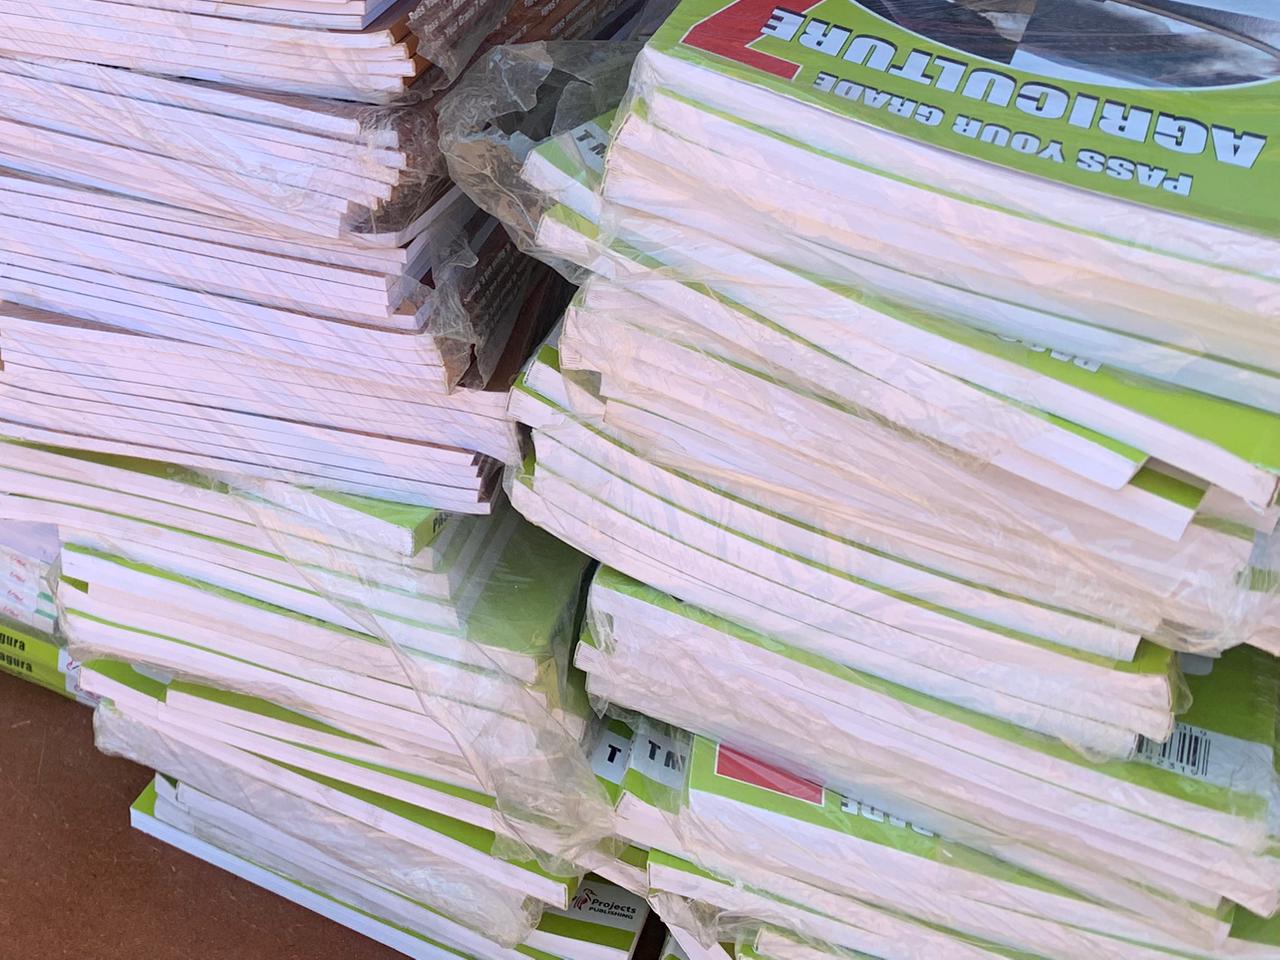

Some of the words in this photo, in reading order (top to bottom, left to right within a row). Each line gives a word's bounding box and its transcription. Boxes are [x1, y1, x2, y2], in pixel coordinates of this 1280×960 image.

[408, 3, 424, 22] Pass
[760, 8, 1268, 169] AGRICULTURE
[814, 71, 945, 127] GRADE
[952, 113, 1068, 164] YOUR
[1076, 147, 1194, 198] PASS
[648, 740, 661, 761] T
[588, 906, 634, 920] PUBLISHING
[591, 898, 636, 914] Projects
